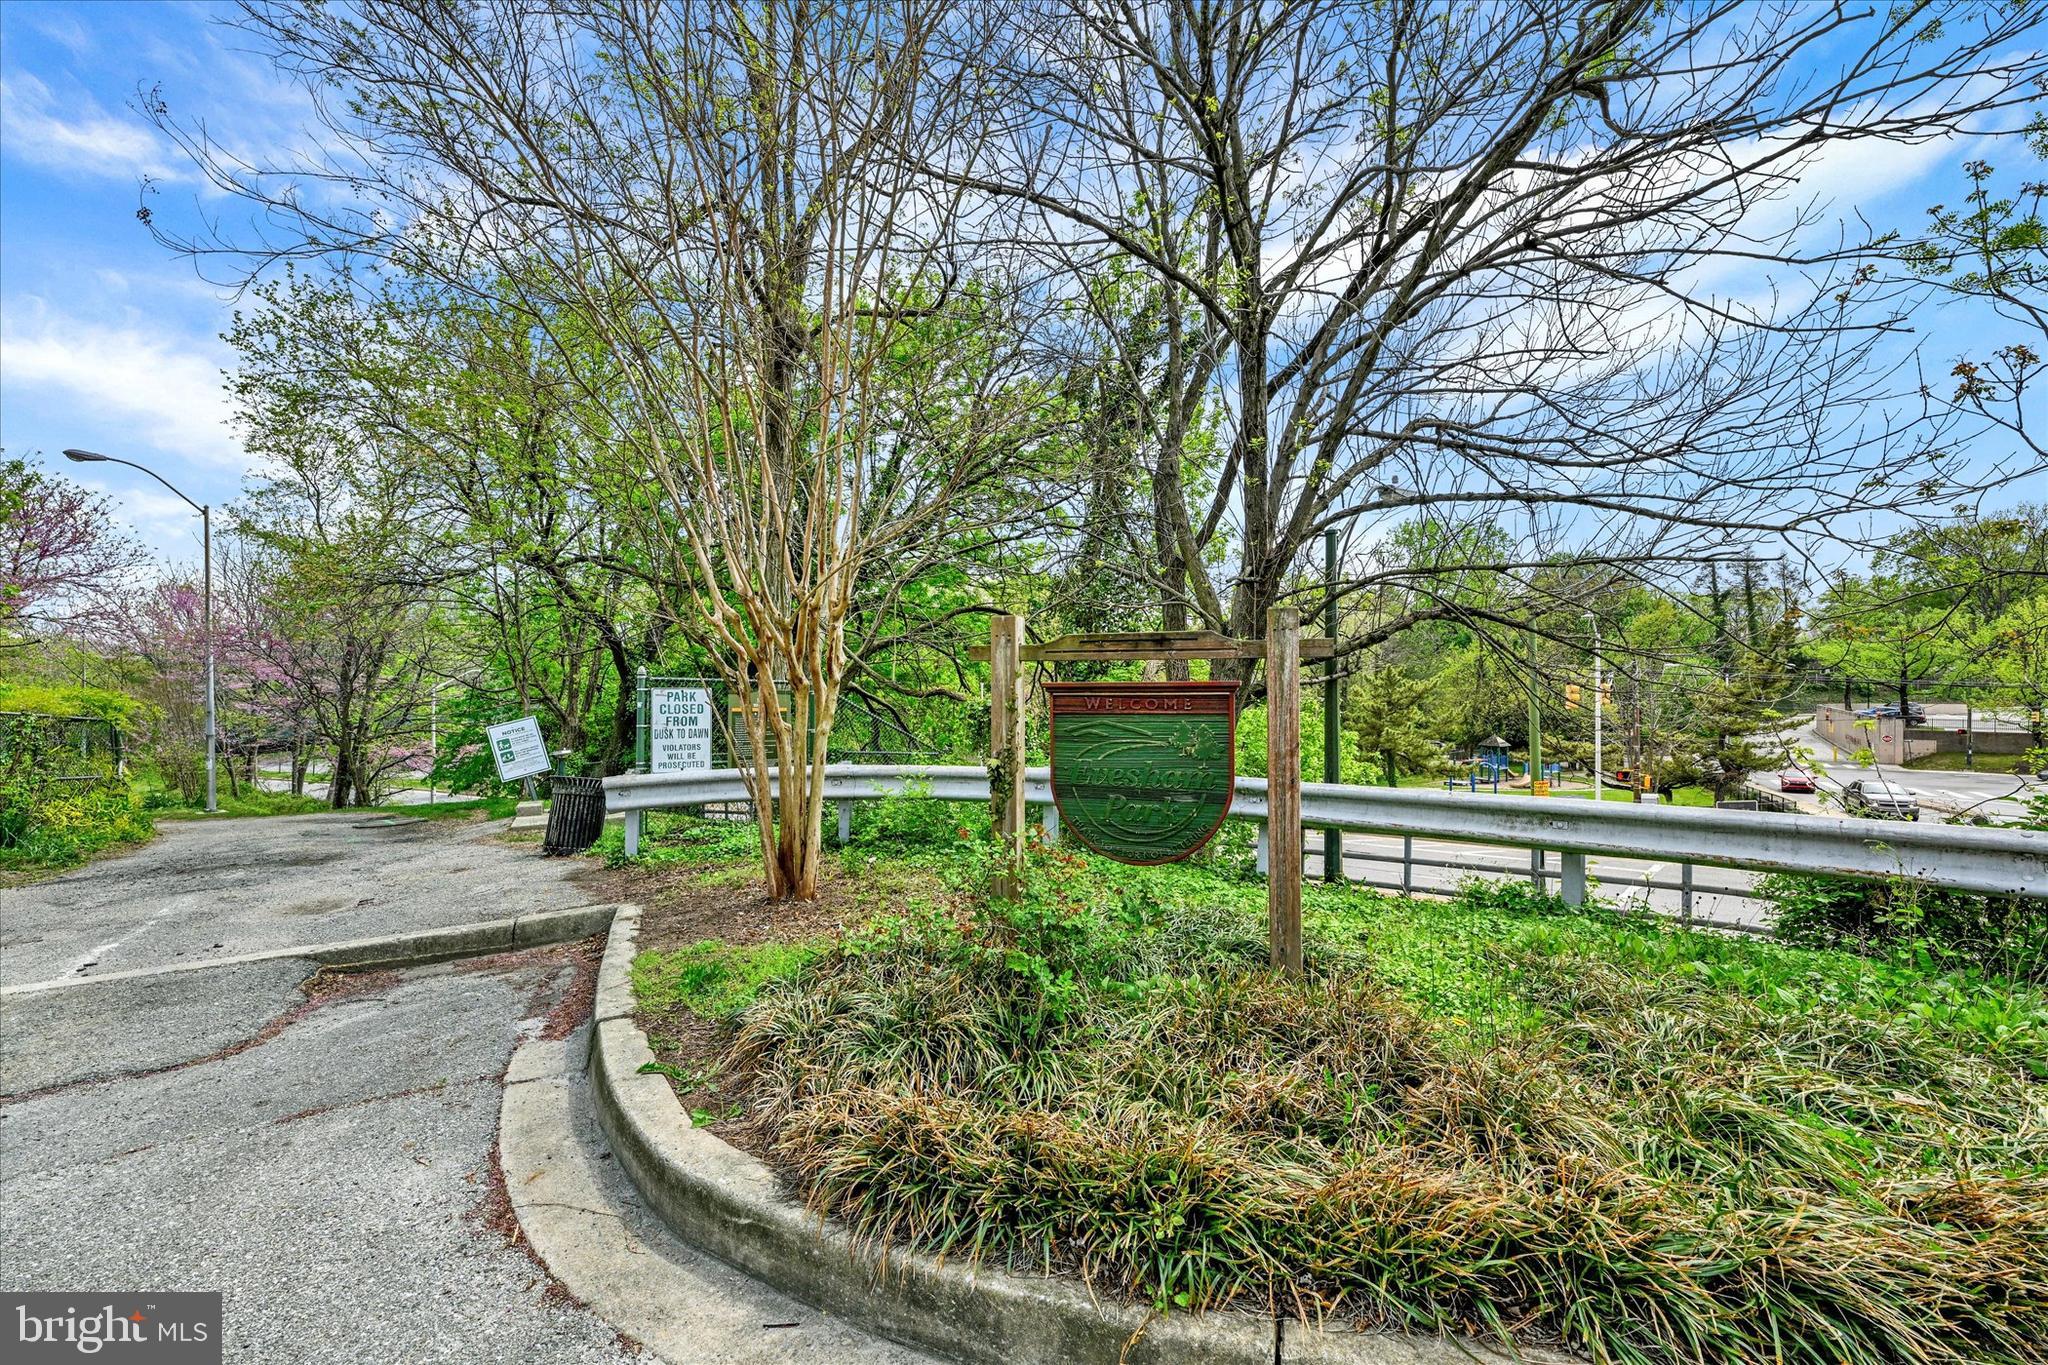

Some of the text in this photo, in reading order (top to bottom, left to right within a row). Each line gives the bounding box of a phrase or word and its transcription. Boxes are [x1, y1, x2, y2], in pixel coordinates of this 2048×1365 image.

[666, 692, 697, 702] PARK
[1084, 697, 1193, 710] WELCOME
[660, 704, 704, 715] CLOSED
[666, 716, 698, 727] FROM
[501, 726, 526, 736] NOTICE
[654, 728, 709, 740] DUSK TO DAWN
[658, 761, 705, 769] PROSECUTED
[1069, 758, 1217, 790] Evesham
[1103, 794, 1181, 825] Park
